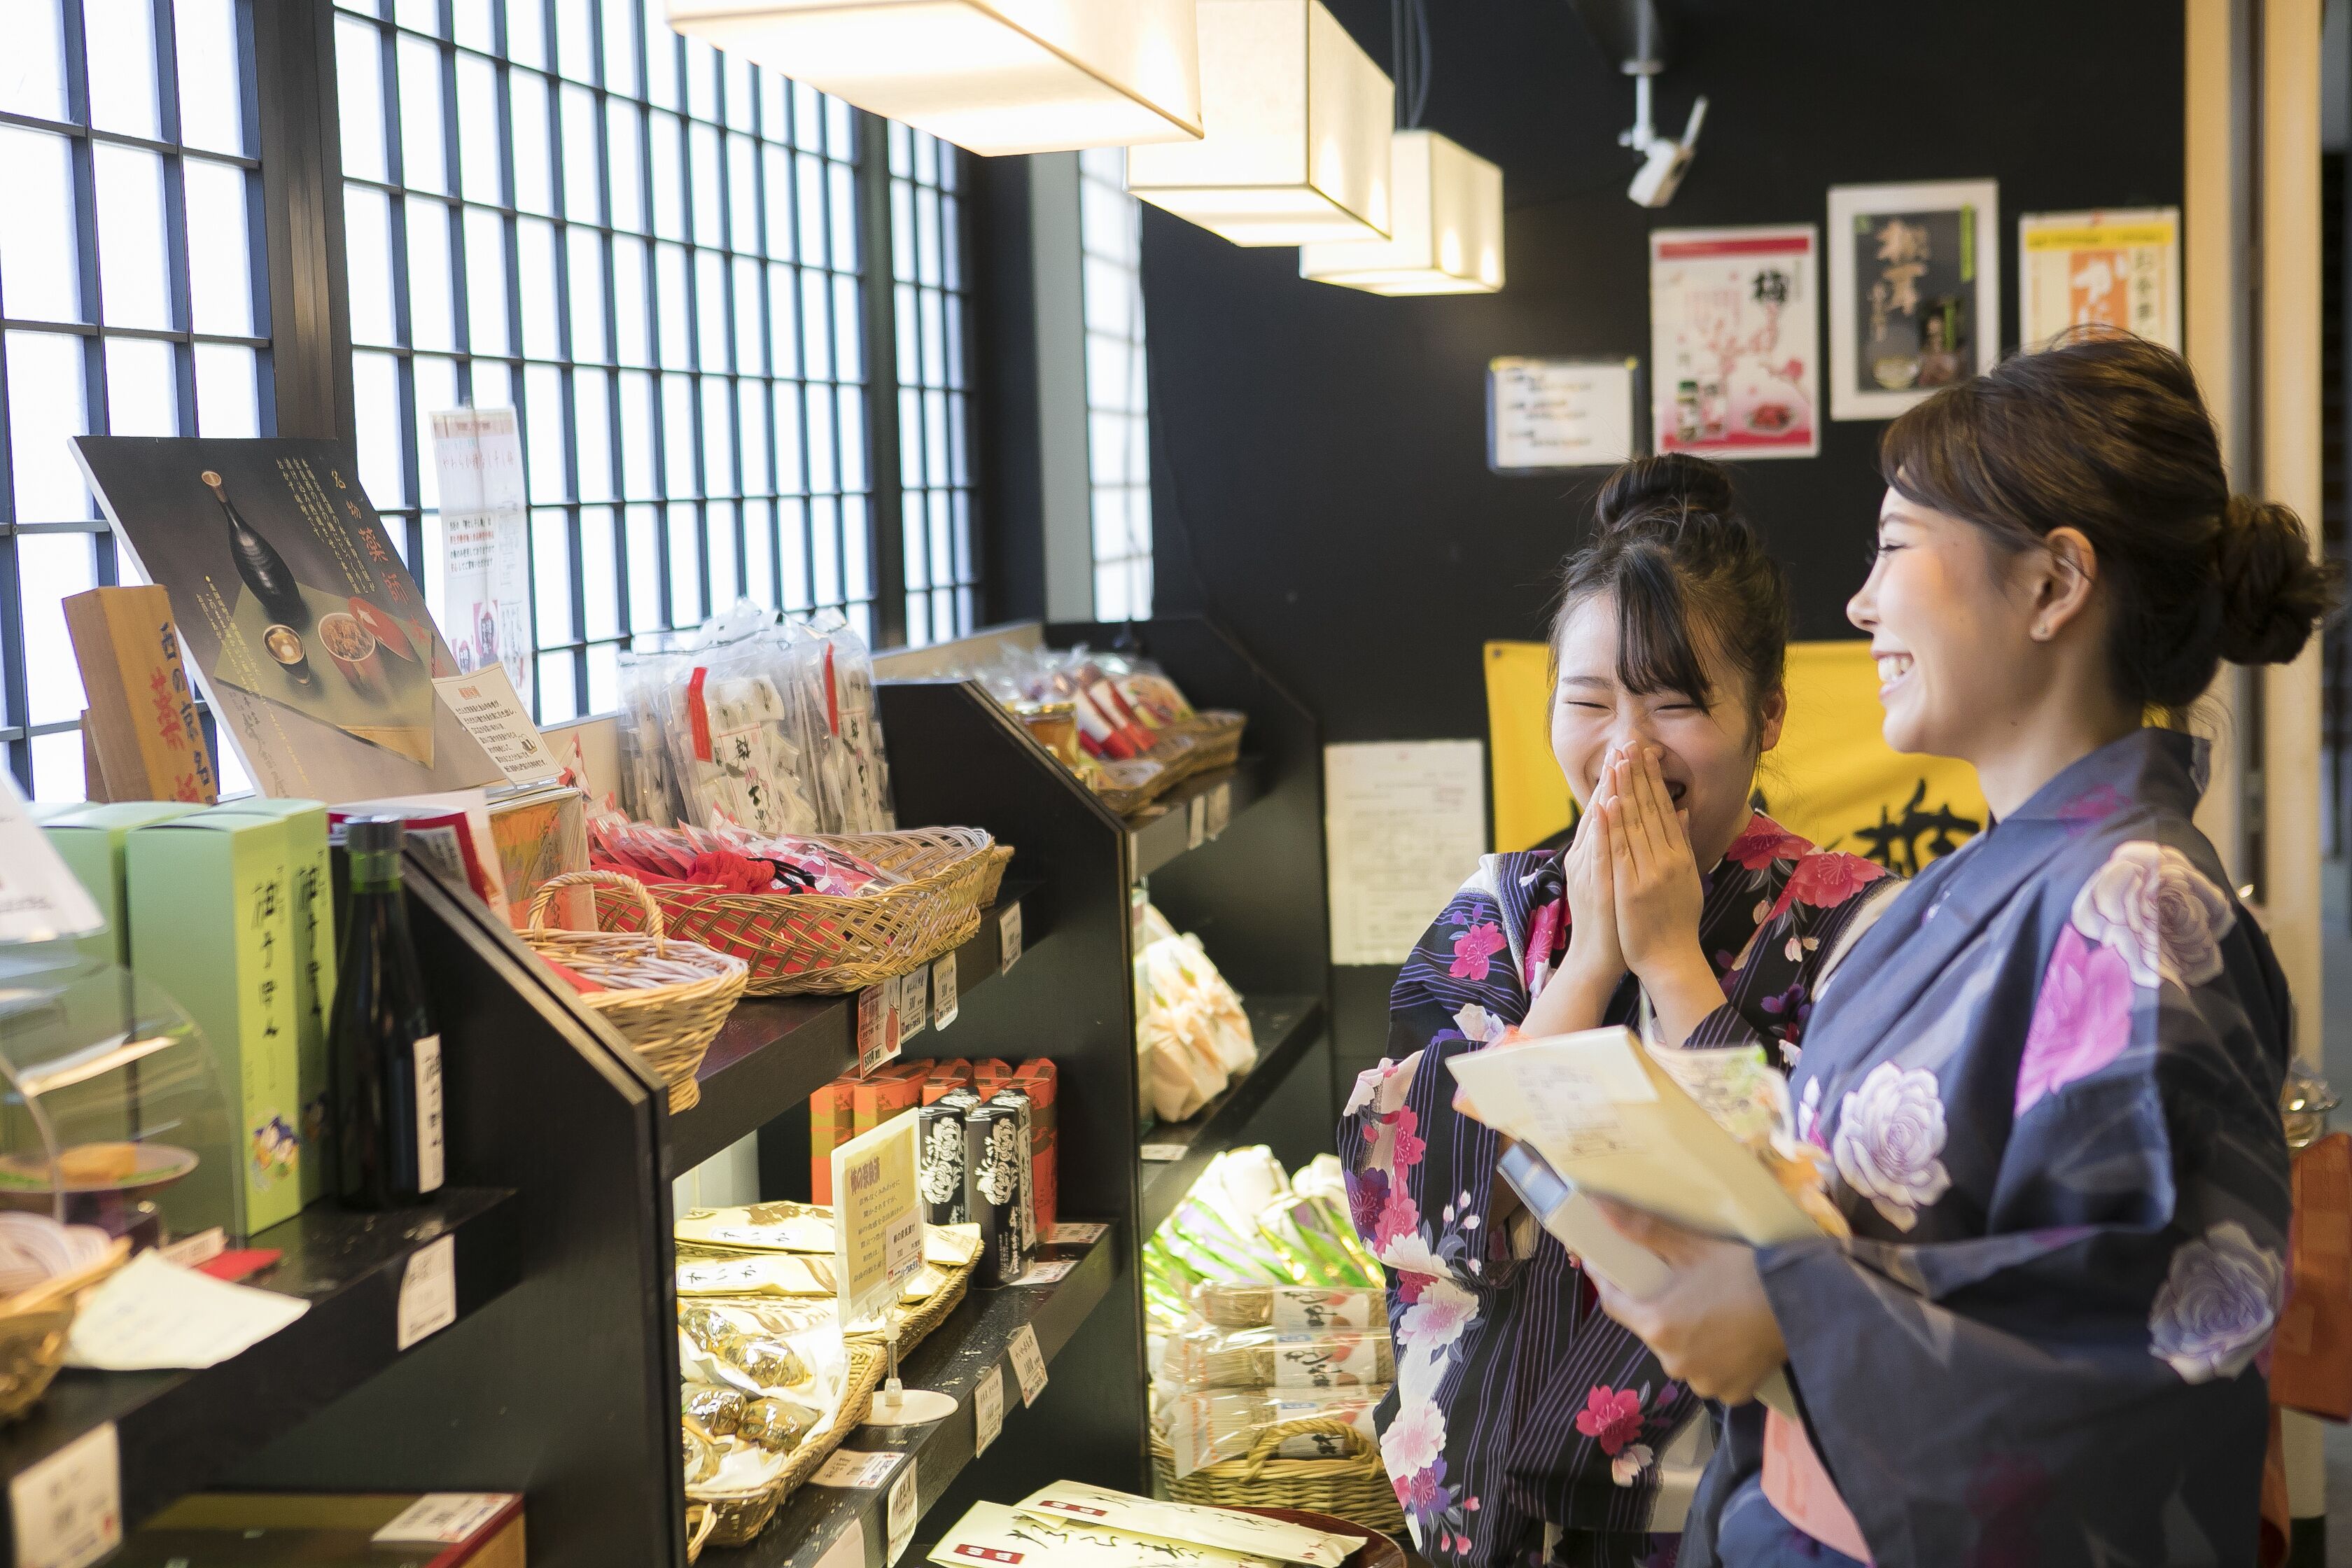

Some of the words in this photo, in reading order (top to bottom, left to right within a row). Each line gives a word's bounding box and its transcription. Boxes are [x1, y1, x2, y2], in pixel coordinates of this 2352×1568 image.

[720, 1231, 790, 1243] すいか
[686, 1265, 756, 1284] すいか
